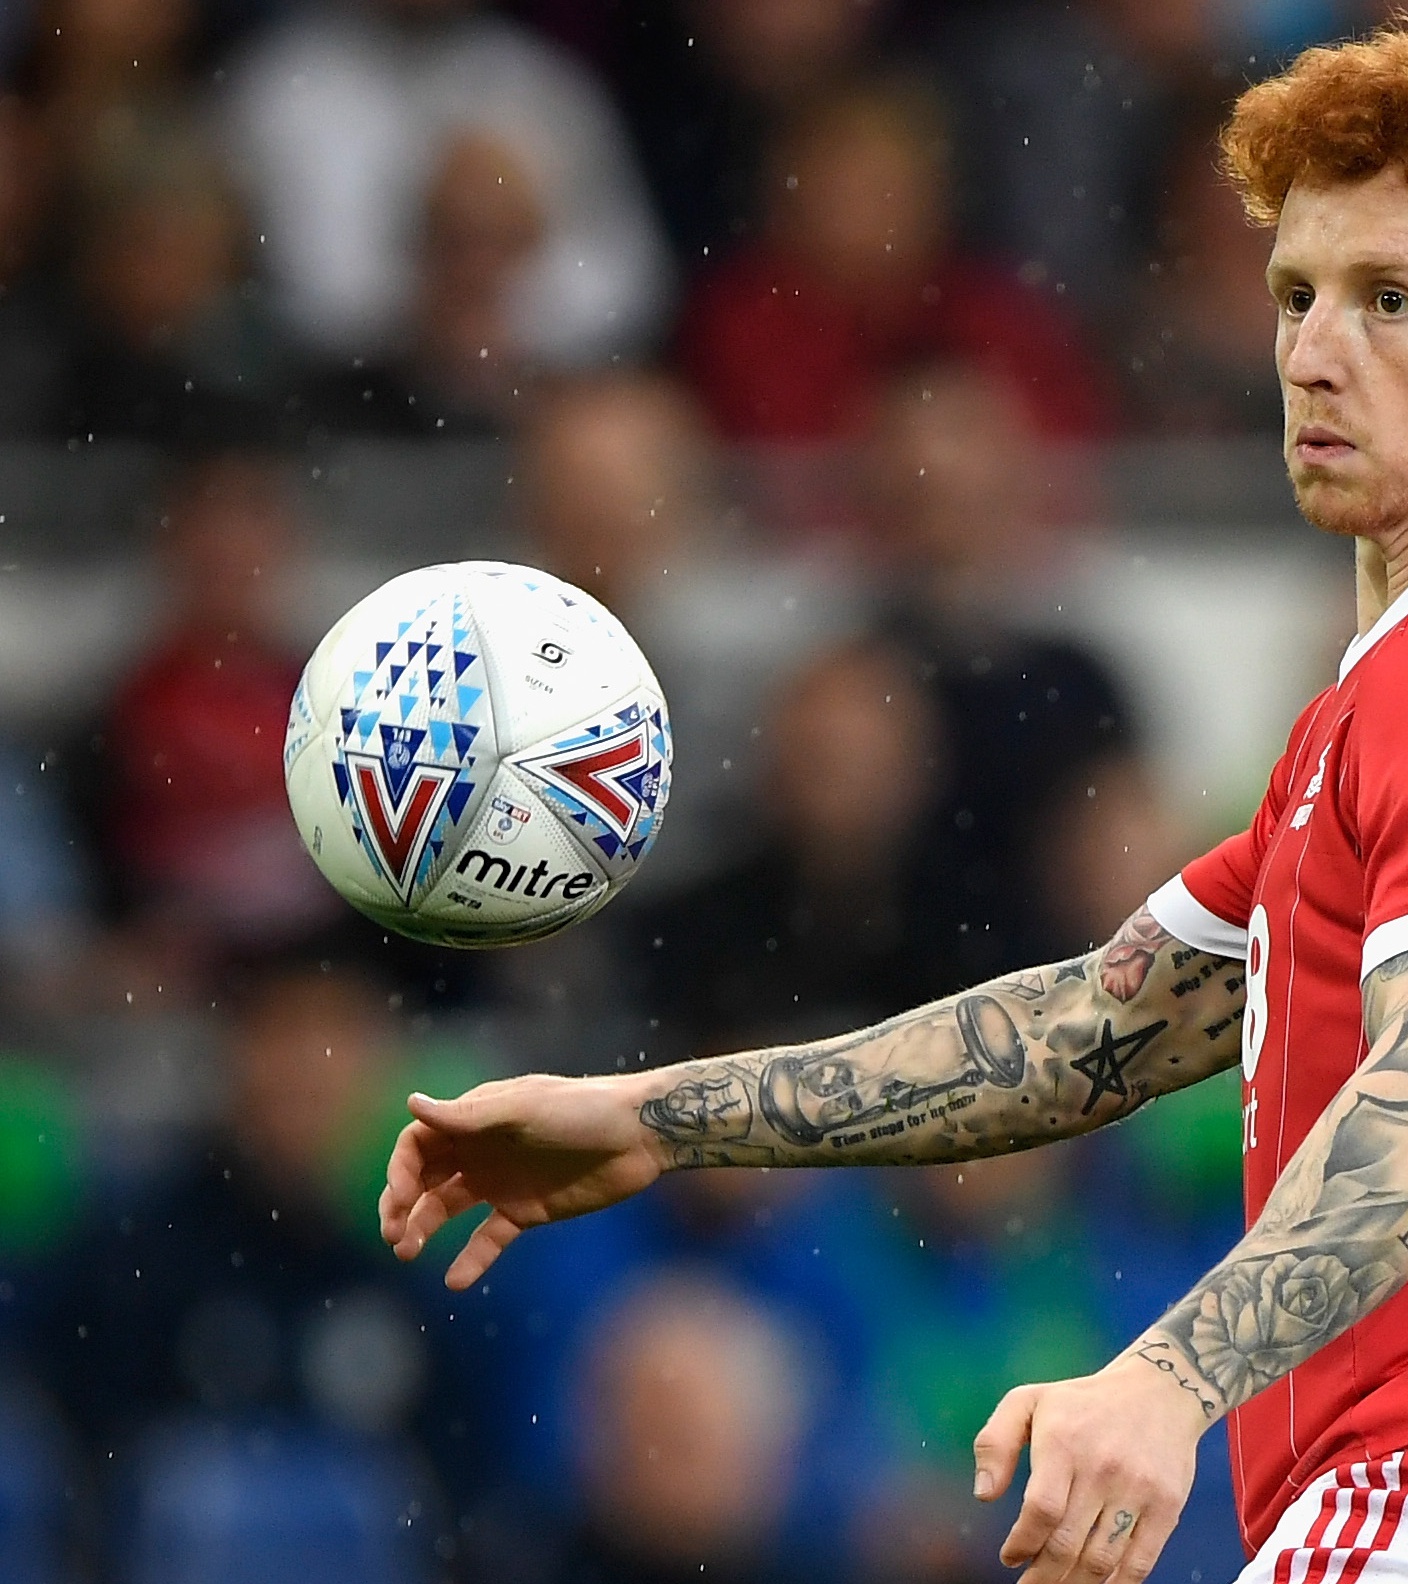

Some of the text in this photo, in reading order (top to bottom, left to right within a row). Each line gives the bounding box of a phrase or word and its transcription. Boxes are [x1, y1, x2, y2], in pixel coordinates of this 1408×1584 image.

[456, 850, 594, 899] mitre
[907, 1112, 927, 1128] for
[1129, 1340, 1216, 1419] Love
